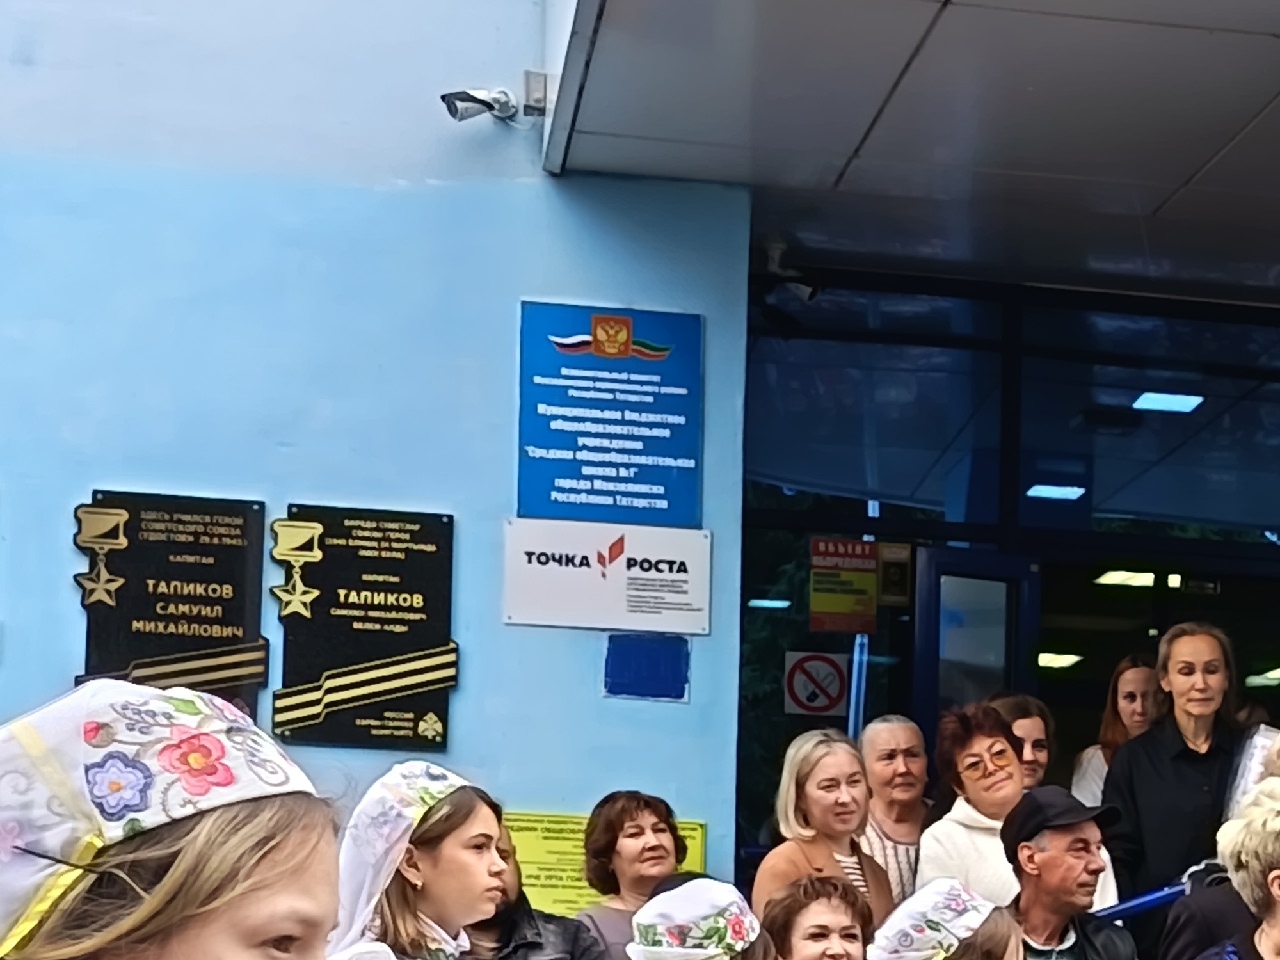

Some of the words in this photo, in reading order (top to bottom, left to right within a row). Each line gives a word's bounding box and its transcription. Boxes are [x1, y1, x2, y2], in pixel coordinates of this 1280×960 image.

[524, 551, 591, 568] ТОЧКА
[626, 557, 688, 574] РОСТА
[146, 579, 233, 599] ТАПИКОВ
[337, 588, 424, 608] ТАПИКОВ
[155, 601, 223, 618] САМУИЛ
[131, 619, 244, 638] МИХАЙЛОВИЧ
